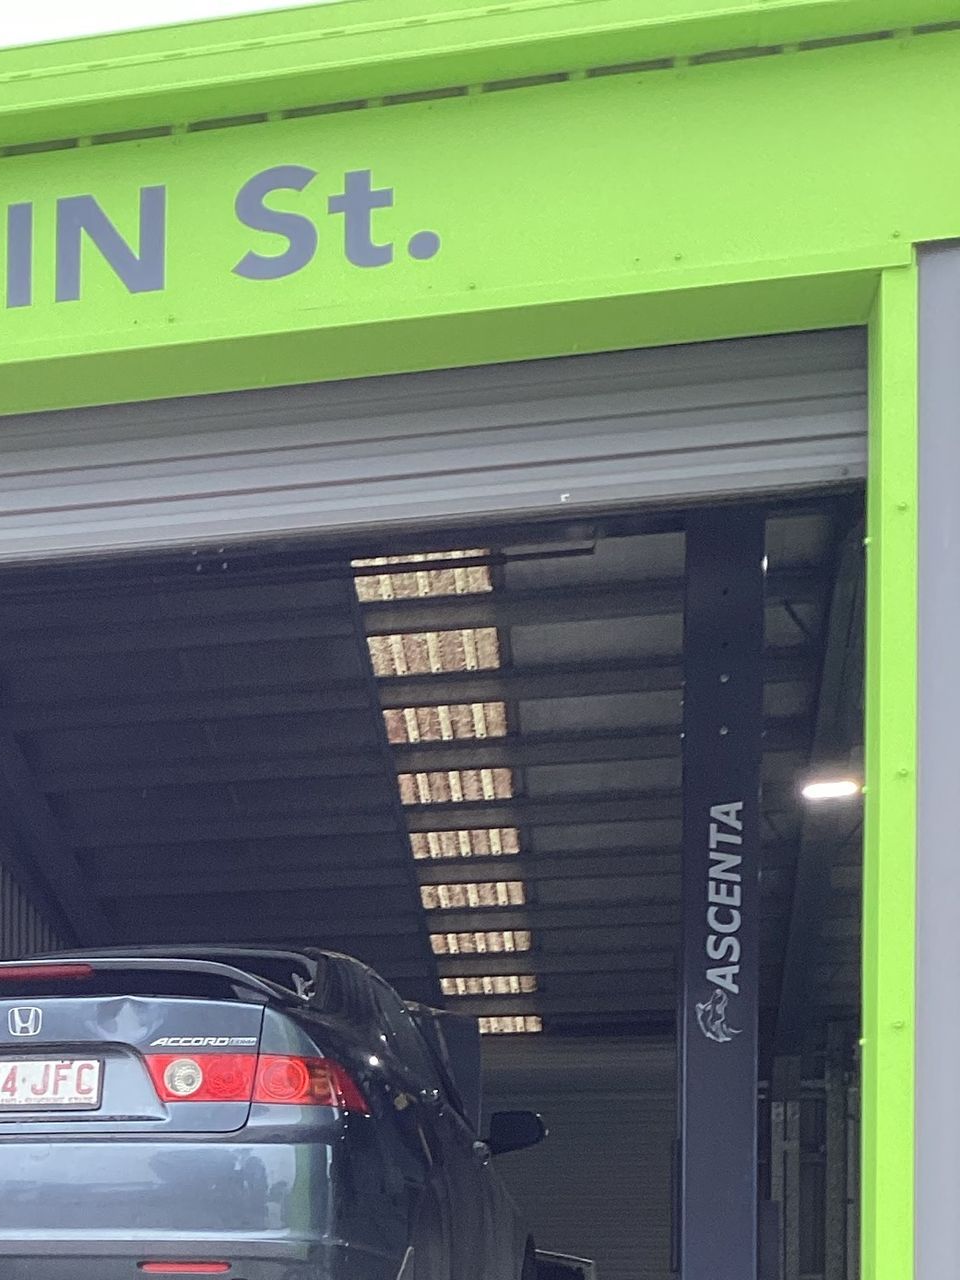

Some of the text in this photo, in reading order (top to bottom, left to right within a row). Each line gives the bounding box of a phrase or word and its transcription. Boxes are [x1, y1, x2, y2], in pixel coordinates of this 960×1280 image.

[230, 164, 441, 282] St.
[706, 801, 743, 995] ASCENTA
[149, 1036, 230, 1047] ACCORD
